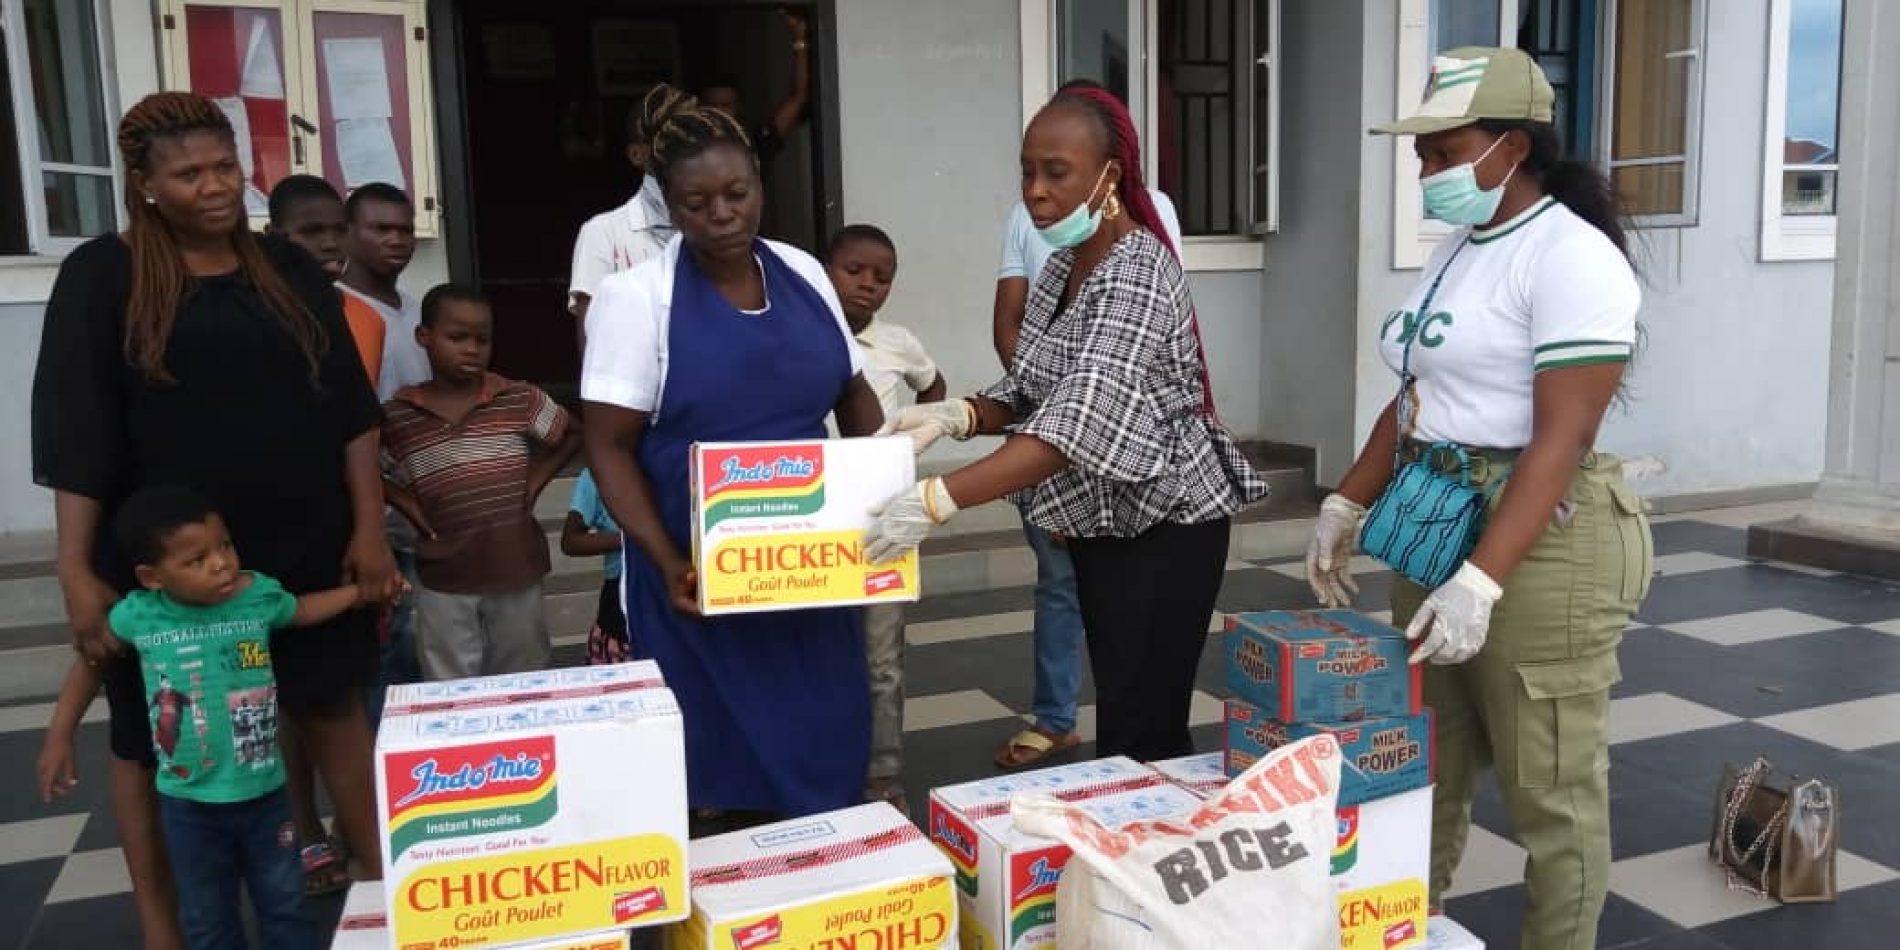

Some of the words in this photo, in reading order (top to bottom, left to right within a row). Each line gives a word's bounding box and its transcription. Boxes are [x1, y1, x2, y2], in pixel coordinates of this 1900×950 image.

[715, 539, 858, 575] CHICKEN
[786, 572, 828, 590] Poulet
[1372, 728, 1409, 747] MILK
[1358, 743, 1420, 771] POWER
[394, 751, 543, 808] Indomie
[426, 818, 469, 834] Instant
[472, 813, 522, 830] Noodles
[1153, 821, 1309, 905] RICE
[408, 855, 603, 912] CHICKEN
[606, 859, 671, 885] FLAVOR
[454, 912, 500, 932] Goût
[506, 901, 564, 925] Poulet
[825, 907, 872, 931] Poulet
[877, 898, 913, 919] Goût
[439, 935, 460, 948] 40
[810, 911, 945, 950] CHICK
